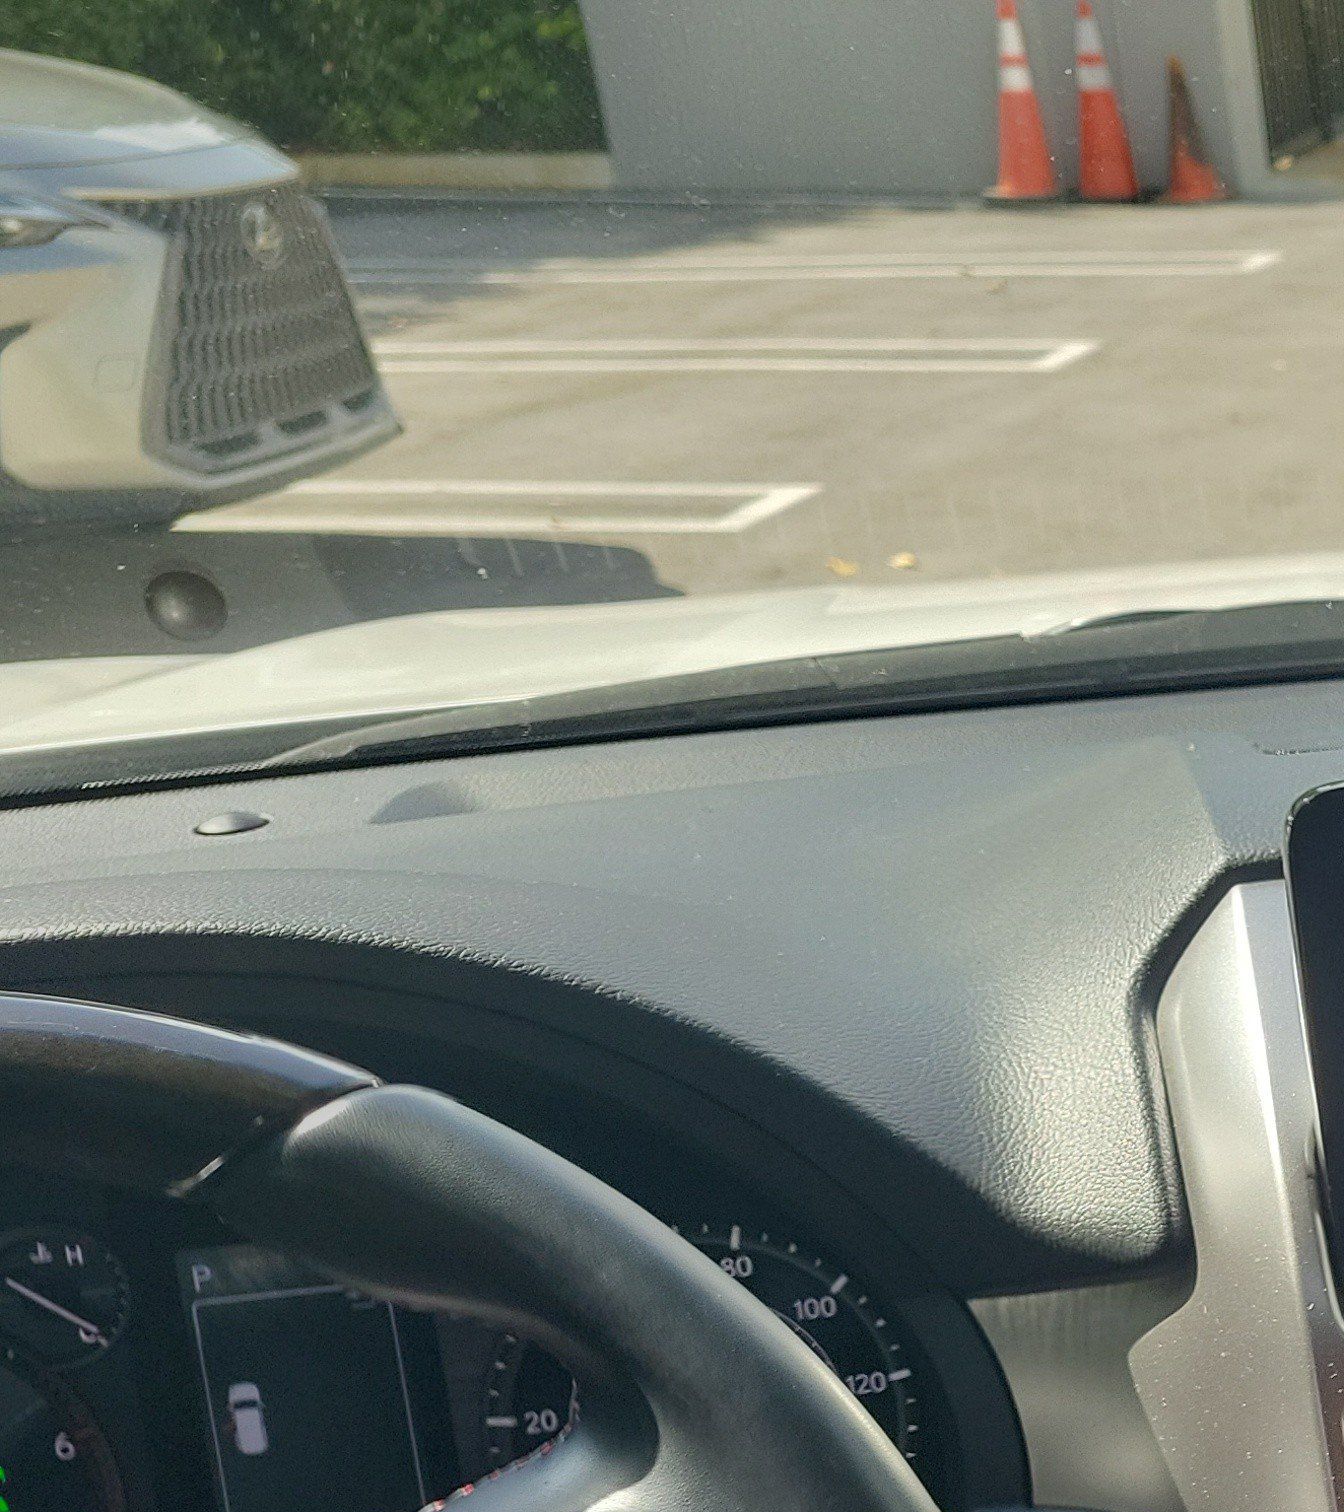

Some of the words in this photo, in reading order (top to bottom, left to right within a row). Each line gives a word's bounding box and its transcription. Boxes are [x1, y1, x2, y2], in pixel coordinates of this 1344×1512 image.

[64, 1243, 84, 1267] H
[191, 1263, 213, 1292] P
[793, 1296, 838, 1321] 100
[845, 1371, 887, 1396] 120
[523, 1409, 558, 1435] 20
[54, 1431, 76, 1461] 6
